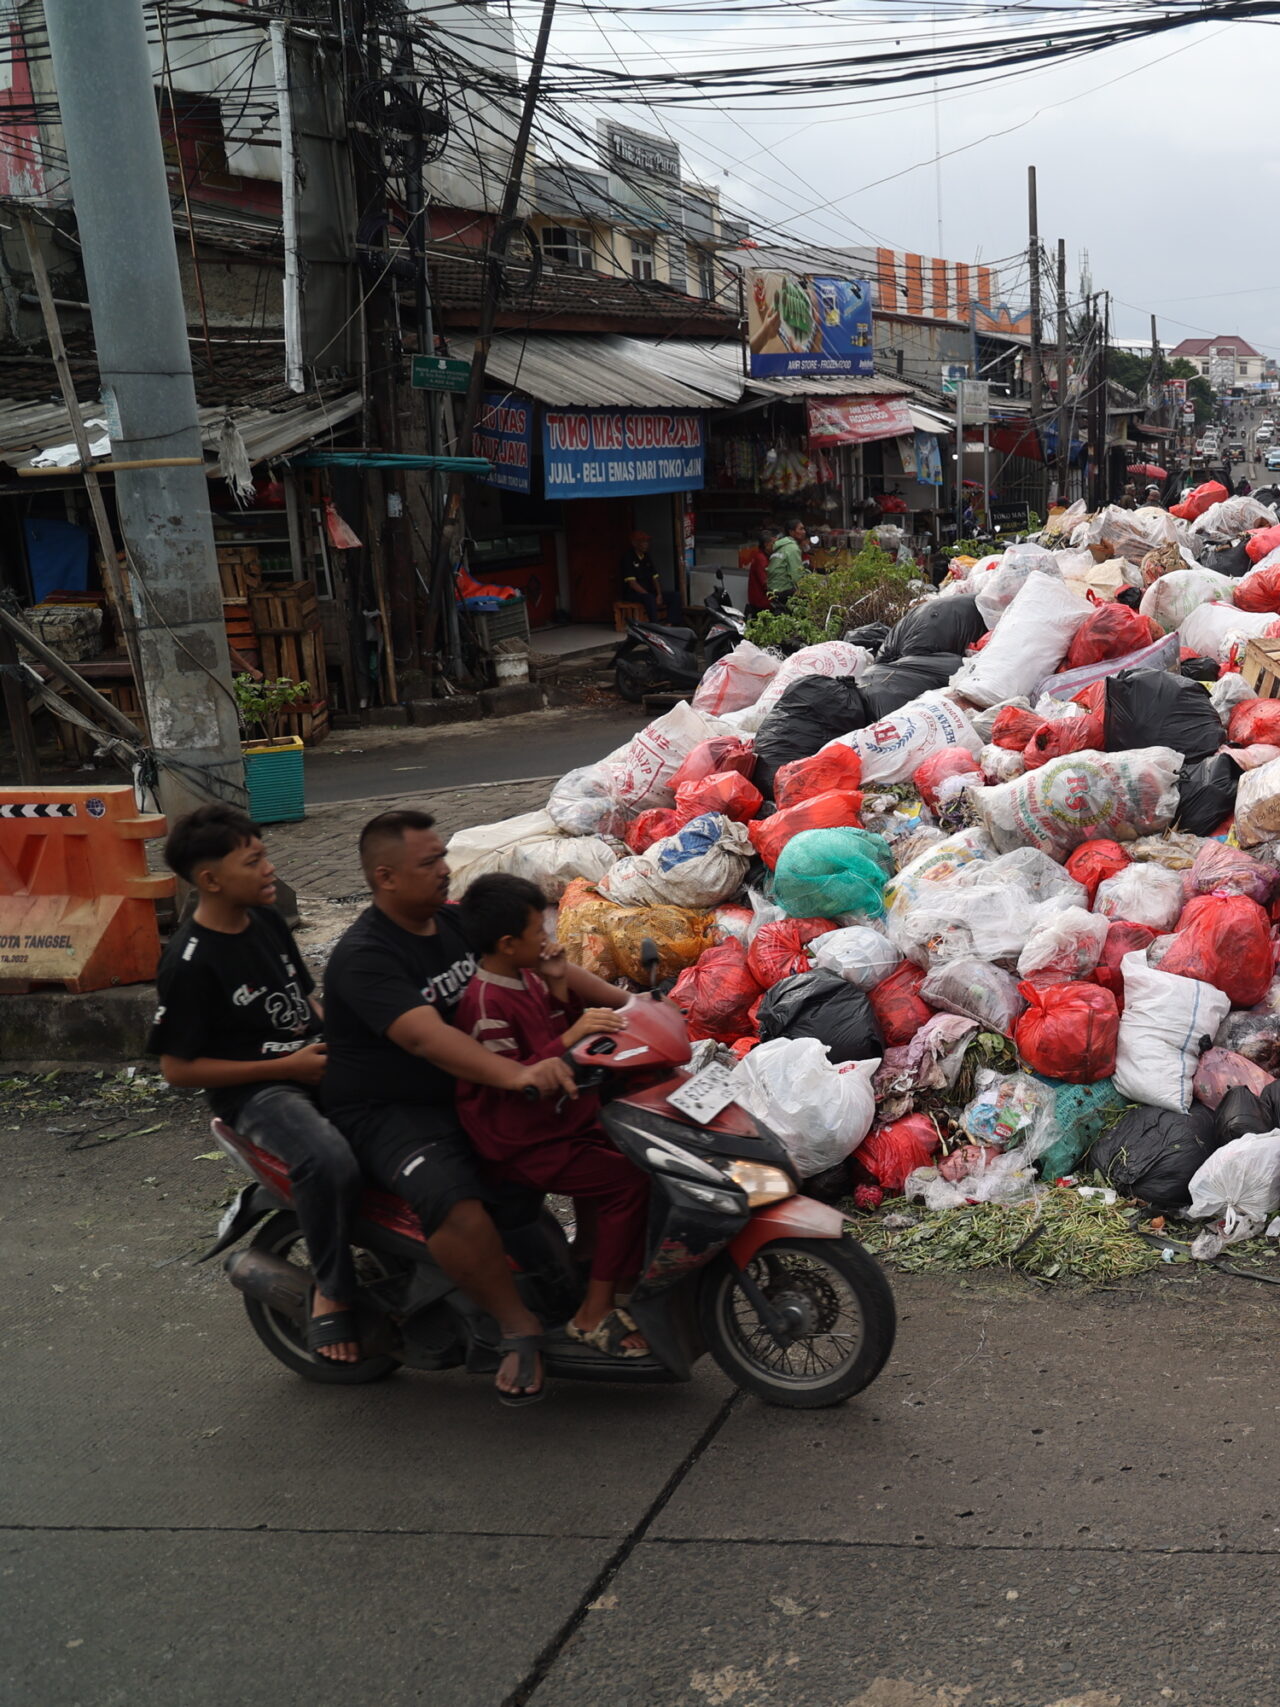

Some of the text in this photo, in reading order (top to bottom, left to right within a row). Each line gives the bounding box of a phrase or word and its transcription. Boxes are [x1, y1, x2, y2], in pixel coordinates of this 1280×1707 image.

[838, 359, 852, 369] FOOD
[498, 407, 526, 434] MAS
[546, 413, 590, 450] TOKO
[592, 414, 623, 449] MAS
[548, 462, 576, 484] JUAL
[583, 461, 606, 483] BELI
[608, 460, 635, 482] EMAS
[636, 460, 657, 480] DARI
[658, 458, 681, 478] TOKO
[682, 457, 701, 477] LAIN
[993, 512, 1011, 520] TOKO
[935, 713, 956, 744] KETAN
[0, 934, 72, 949] OTA TANGSEL
